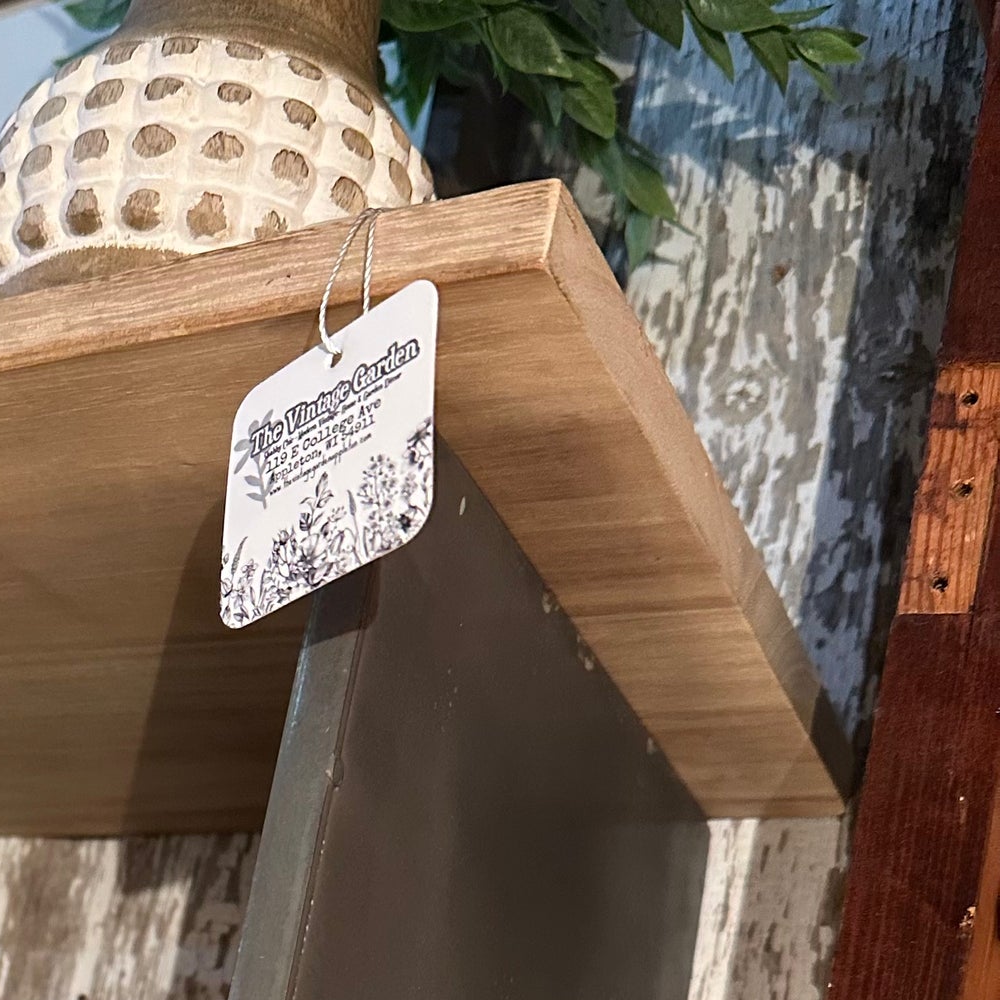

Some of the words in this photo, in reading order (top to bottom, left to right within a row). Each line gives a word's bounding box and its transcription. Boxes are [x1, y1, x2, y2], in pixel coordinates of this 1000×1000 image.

[249, 418, 285, 459] The
[285, 380, 351, 435] Vintage
[351, 338, 420, 394] Garden
[265, 451, 288, 474] 119
[291, 445, 299, 460] E
[302, 414, 354, 451] College
[358, 398, 381, 420] Ave
[269, 450, 323, 485] Appleton,
[325, 434, 338, 451] WI
